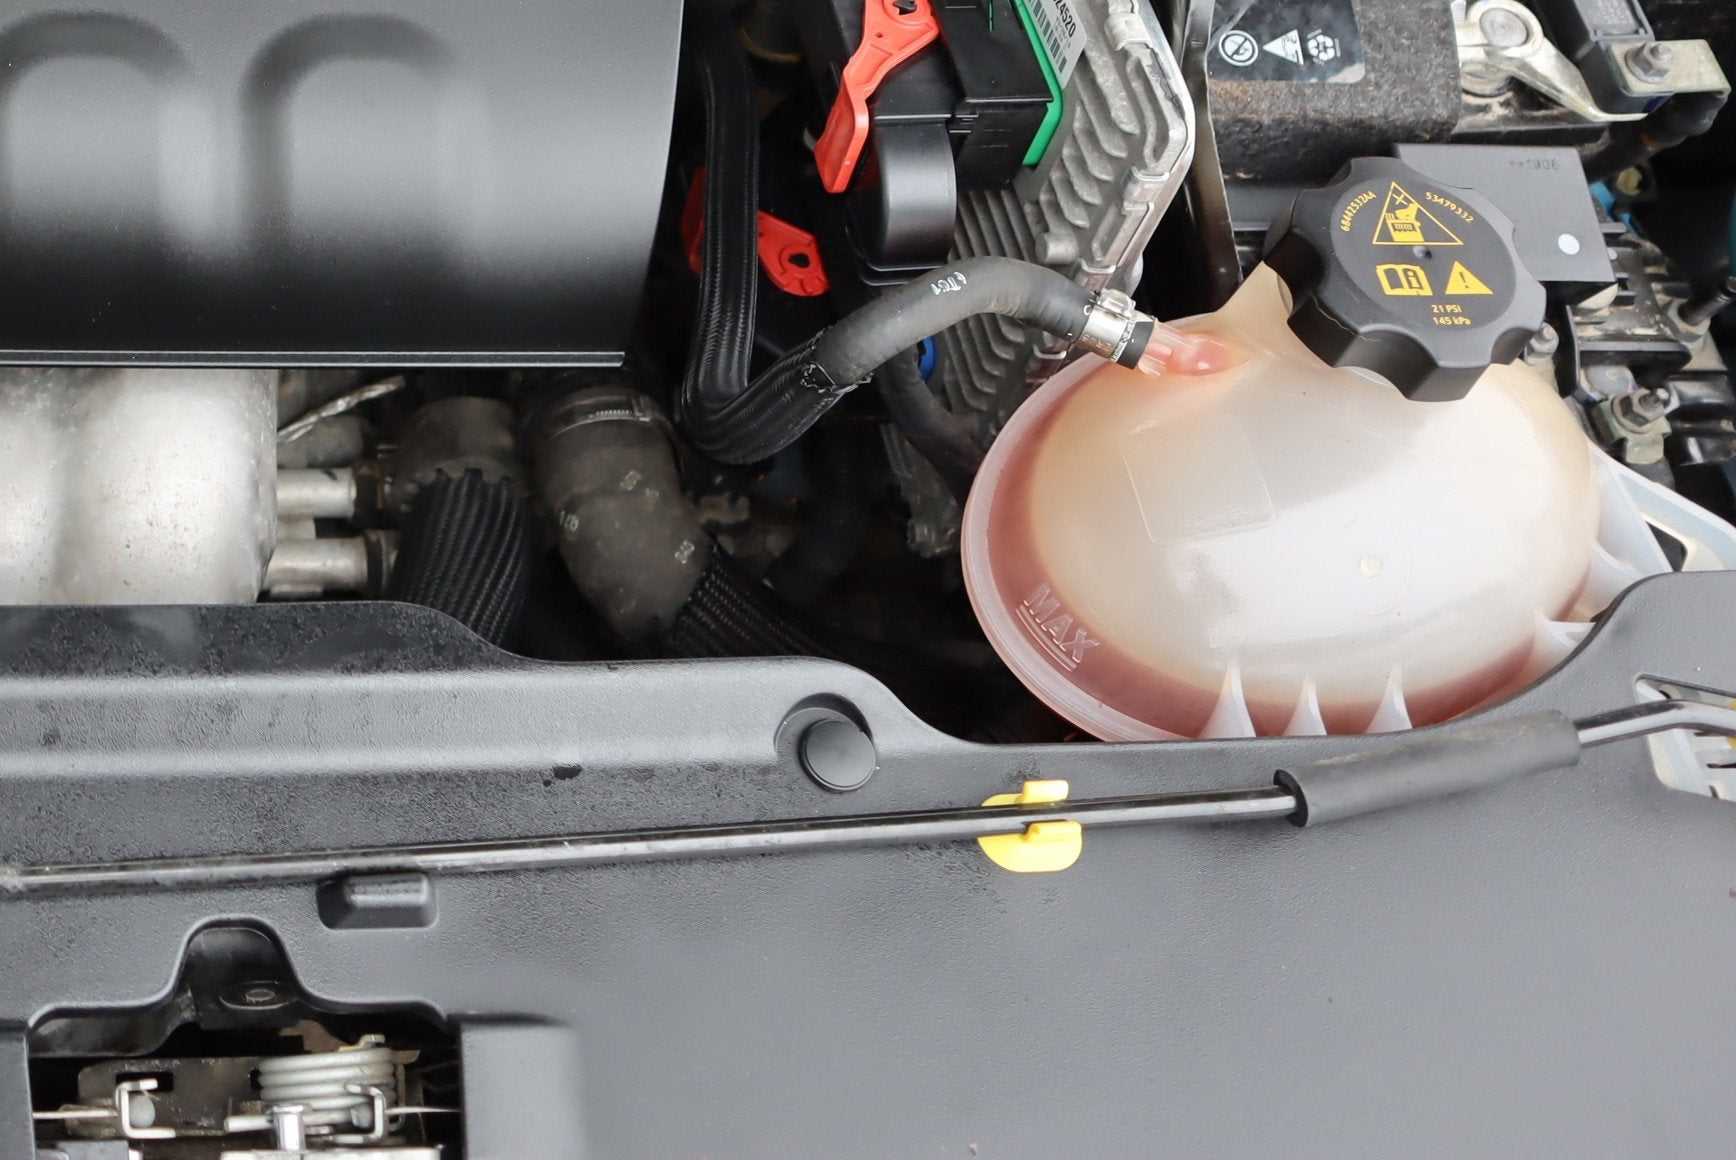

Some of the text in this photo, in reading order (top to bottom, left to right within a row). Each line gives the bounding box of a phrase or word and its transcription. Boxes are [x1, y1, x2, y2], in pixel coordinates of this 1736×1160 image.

[1425, 191, 1475, 224] 53479332
[1430, 304, 1462, 313] 21 PSI
[1432, 316, 1471, 325] 145 kPa
[1022, 583, 1100, 663] MAX
